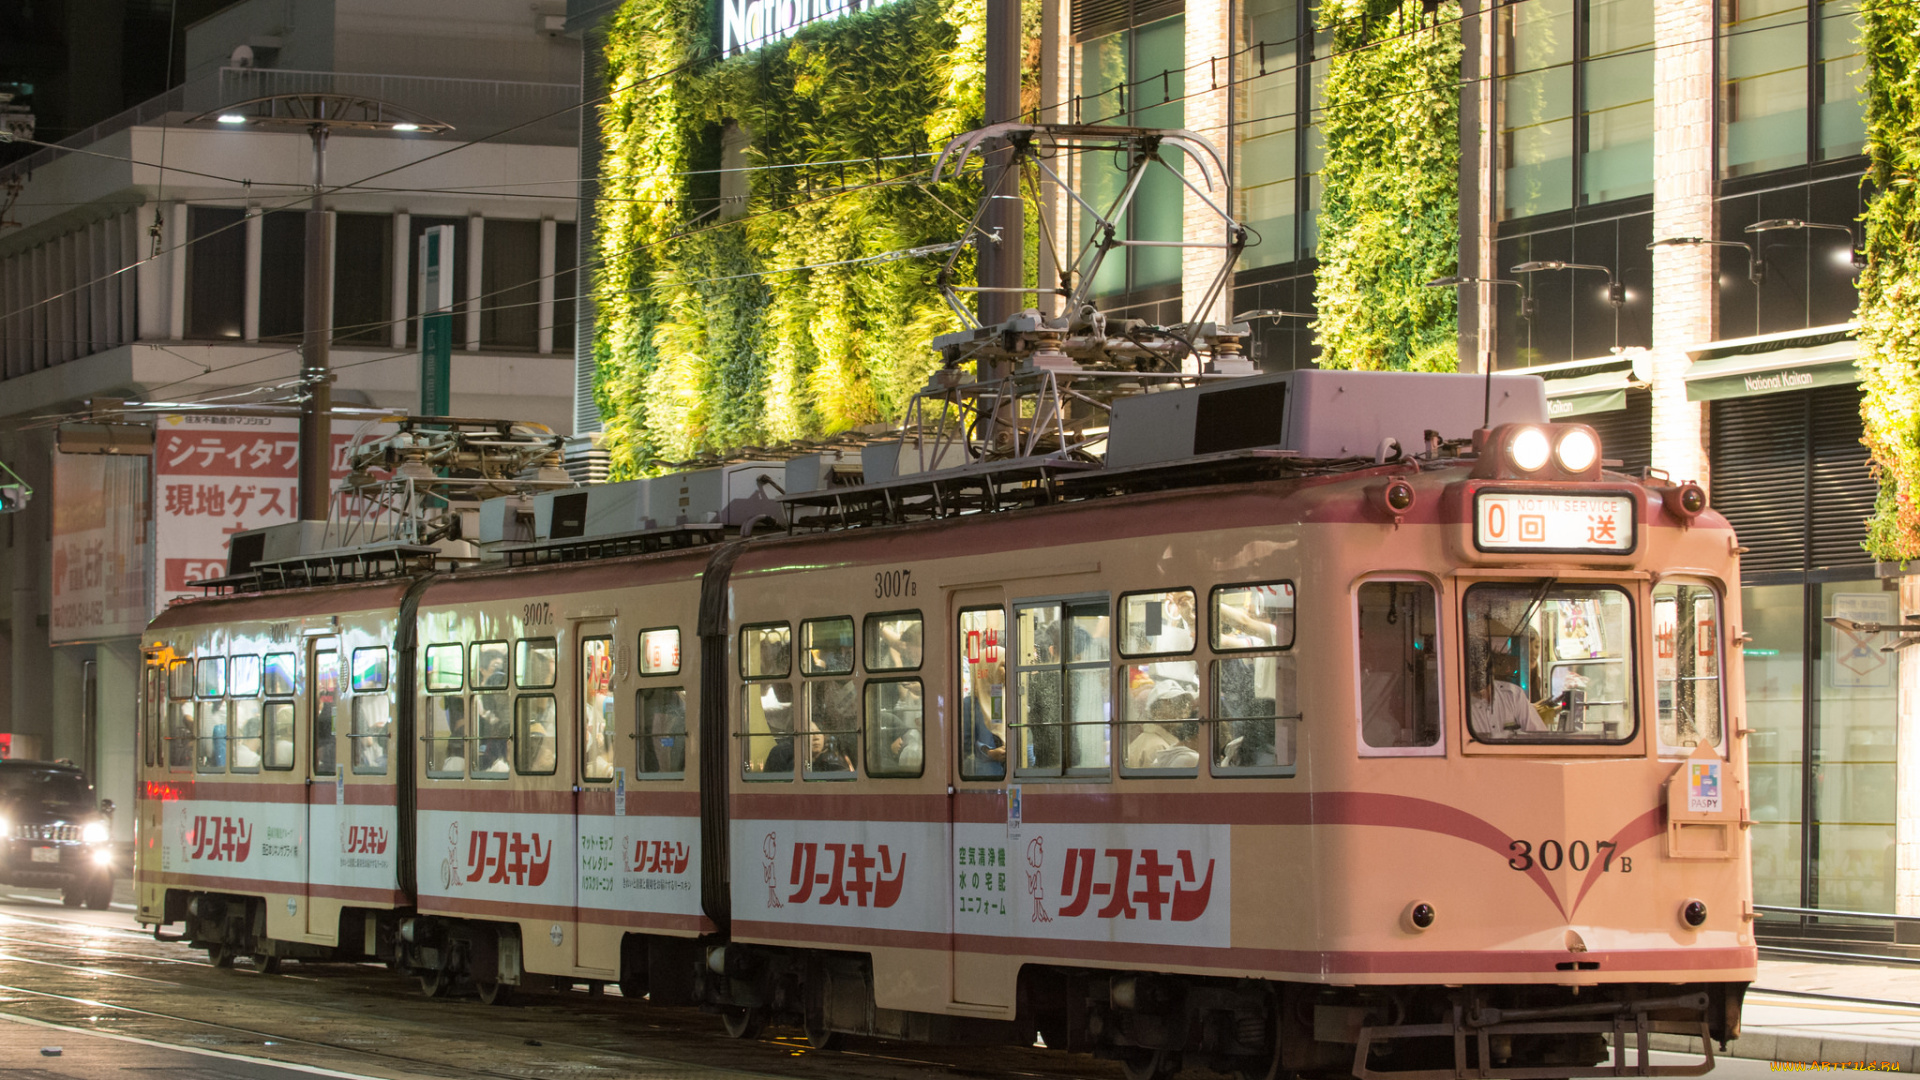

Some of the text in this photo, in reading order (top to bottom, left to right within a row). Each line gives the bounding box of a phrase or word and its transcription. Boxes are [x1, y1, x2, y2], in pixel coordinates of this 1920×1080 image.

[722, 0, 851, 60] Nationa
[1743, 371, 1813, 391] National Kaikan
[1546, 399, 1574, 415] Kaikan
[1517, 500, 1618, 512] NOT IN SERVICE
[1488, 503, 1505, 538] 0
[1691, 799, 1718, 808] PASPY
[191, 816, 253, 863] リースキン
[347, 825, 389, 855] リースキン
[466, 830, 552, 887] リースキン
[581, 855, 614, 872] トイレタリー
[633, 840, 691, 875] リースキン
[958, 846, 1006, 868] 空気清浄機
[788, 842, 907, 908] リースキン
[958, 870, 1006, 892] 水の宅配
[1058, 848, 1216, 922] リースキン
[959, 896, 1006, 916] ユニフォーム
